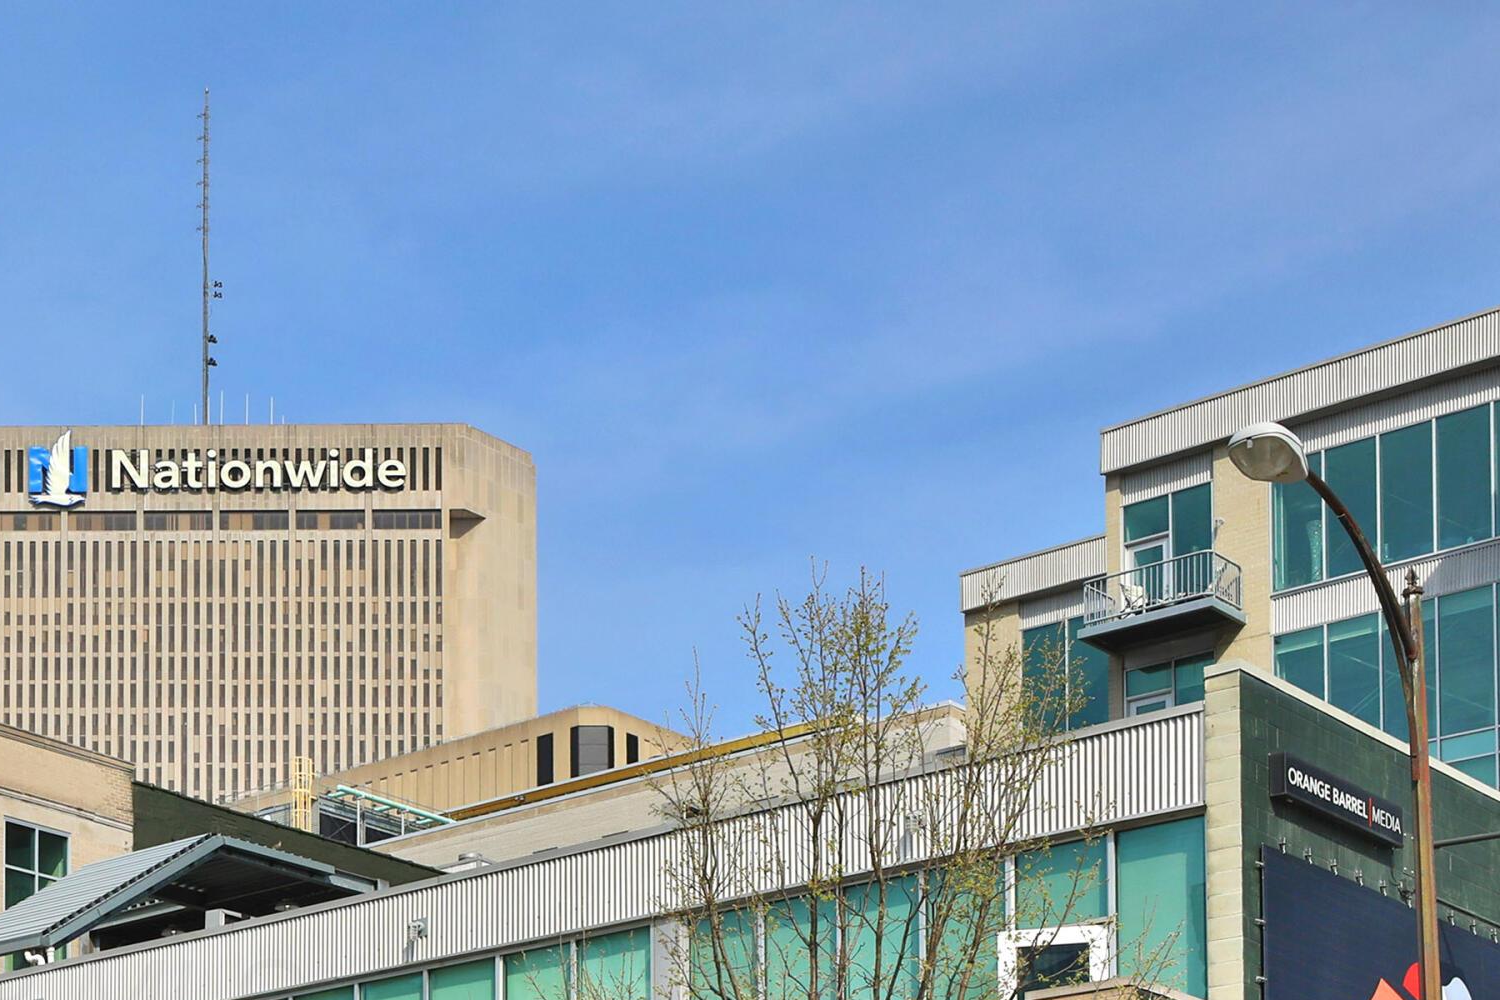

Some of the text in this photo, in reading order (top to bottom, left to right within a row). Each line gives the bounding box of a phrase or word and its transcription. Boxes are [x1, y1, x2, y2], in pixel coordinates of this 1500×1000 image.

[111, 447, 407, 490] Nationwide
[1288, 767, 1402, 835] ORANGE BARREL MEDIA
